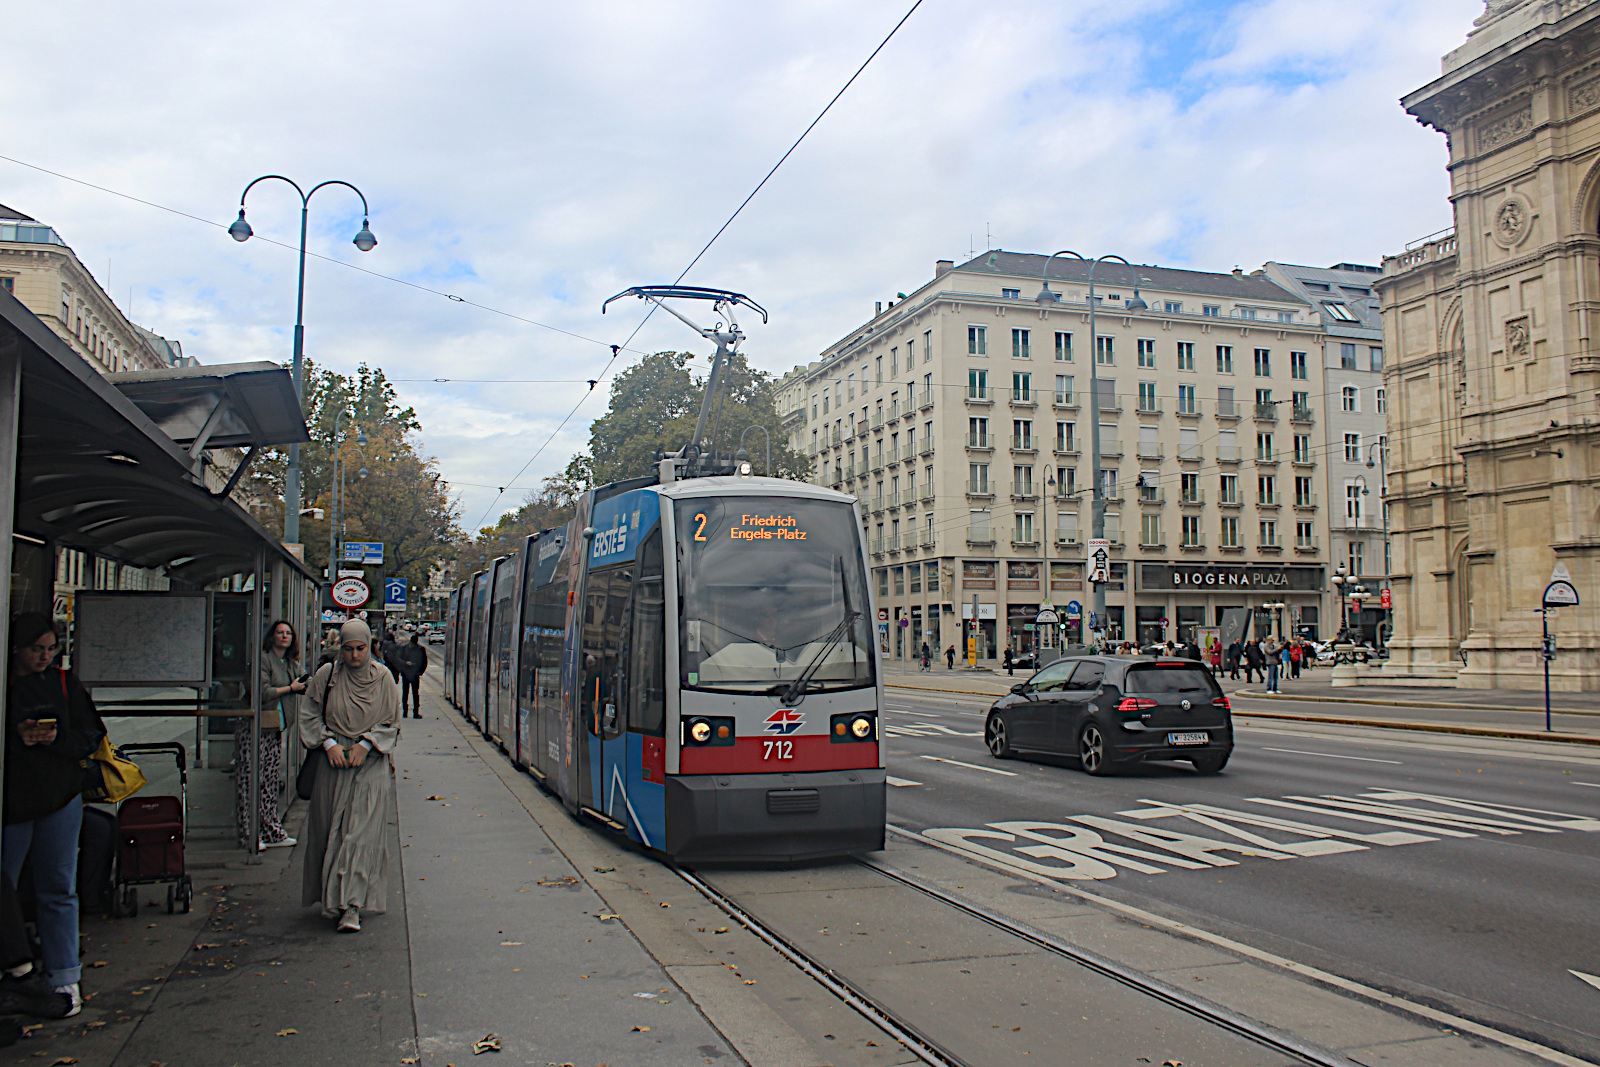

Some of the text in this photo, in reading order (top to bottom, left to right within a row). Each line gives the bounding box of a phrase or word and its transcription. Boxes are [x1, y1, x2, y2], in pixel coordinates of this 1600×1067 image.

[694, 513, 707, 541] 2
[741, 514, 796, 526] Friedrich
[730, 527, 807, 541] Engels-Platz
[1174, 572, 1288, 586] BIOGENA PLAZA
[392, 586, 401, 600] P
[764, 740, 793, 760] 712
[1181, 790, 1600, 847] LINZ
[921, 806, 1372, 881] GRAZ
